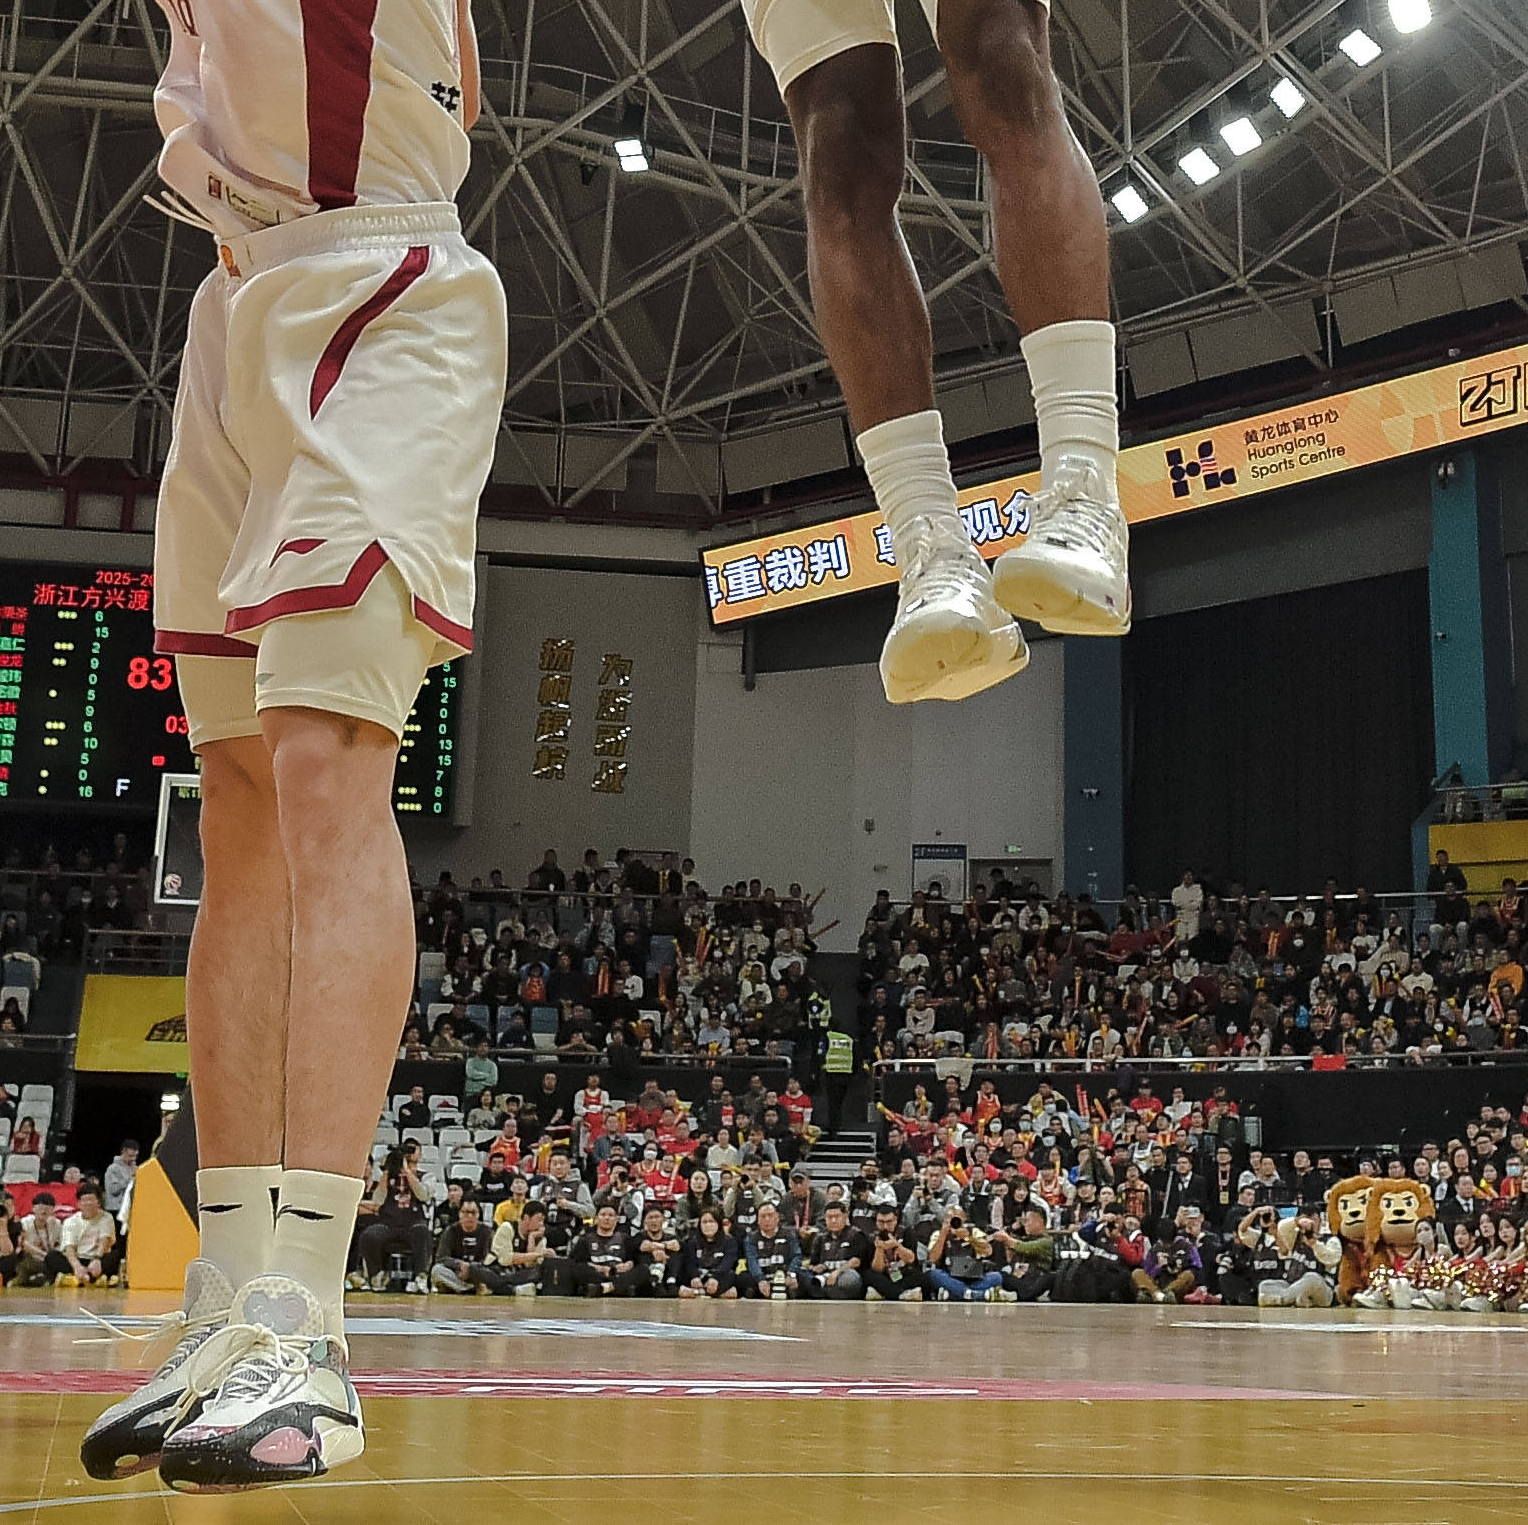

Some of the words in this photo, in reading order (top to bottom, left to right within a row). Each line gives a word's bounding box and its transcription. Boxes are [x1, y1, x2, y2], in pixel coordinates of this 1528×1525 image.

[1243, 408, 1340, 446] 黄龙体育中心
[1247, 432, 1327, 461] Huanglong
[1250, 457, 1296, 480] Sports
[1298, 444, 1346, 467] Centre
[33, 583, 151, 612] 浙江方兴渡
[95, 611, 104, 622] 6
[95, 627, 109, 639] 15
[91, 642, 101, 653] 2
[443, 660, 451, 672] 5
[90, 658, 99, 669] 9
[443, 677, 456, 688] 15
[127, 656, 172, 691] 83
[88, 674, 97, 685] 0
[440, 693, 448, 704] 2
[87, 689, 96, 701] 5
[439, 708, 448, 719] 0
[85, 705, 94, 717] 9
[438, 724, 447, 735] 0
[83, 721, 93, 733] 6
[439, 739, 453, 750] 13
[83, 737, 98, 750] 10
[438, 755, 452, 766] 15
[80, 753, 89, 765] 5
[436, 770, 444, 781] 7
[78, 769, 88, 781] 0
[434, 786, 443, 797] 8
[115, 778, 130, 797] F
[78, 785, 93, 798] 16
[433, 802, 442, 813] 0
